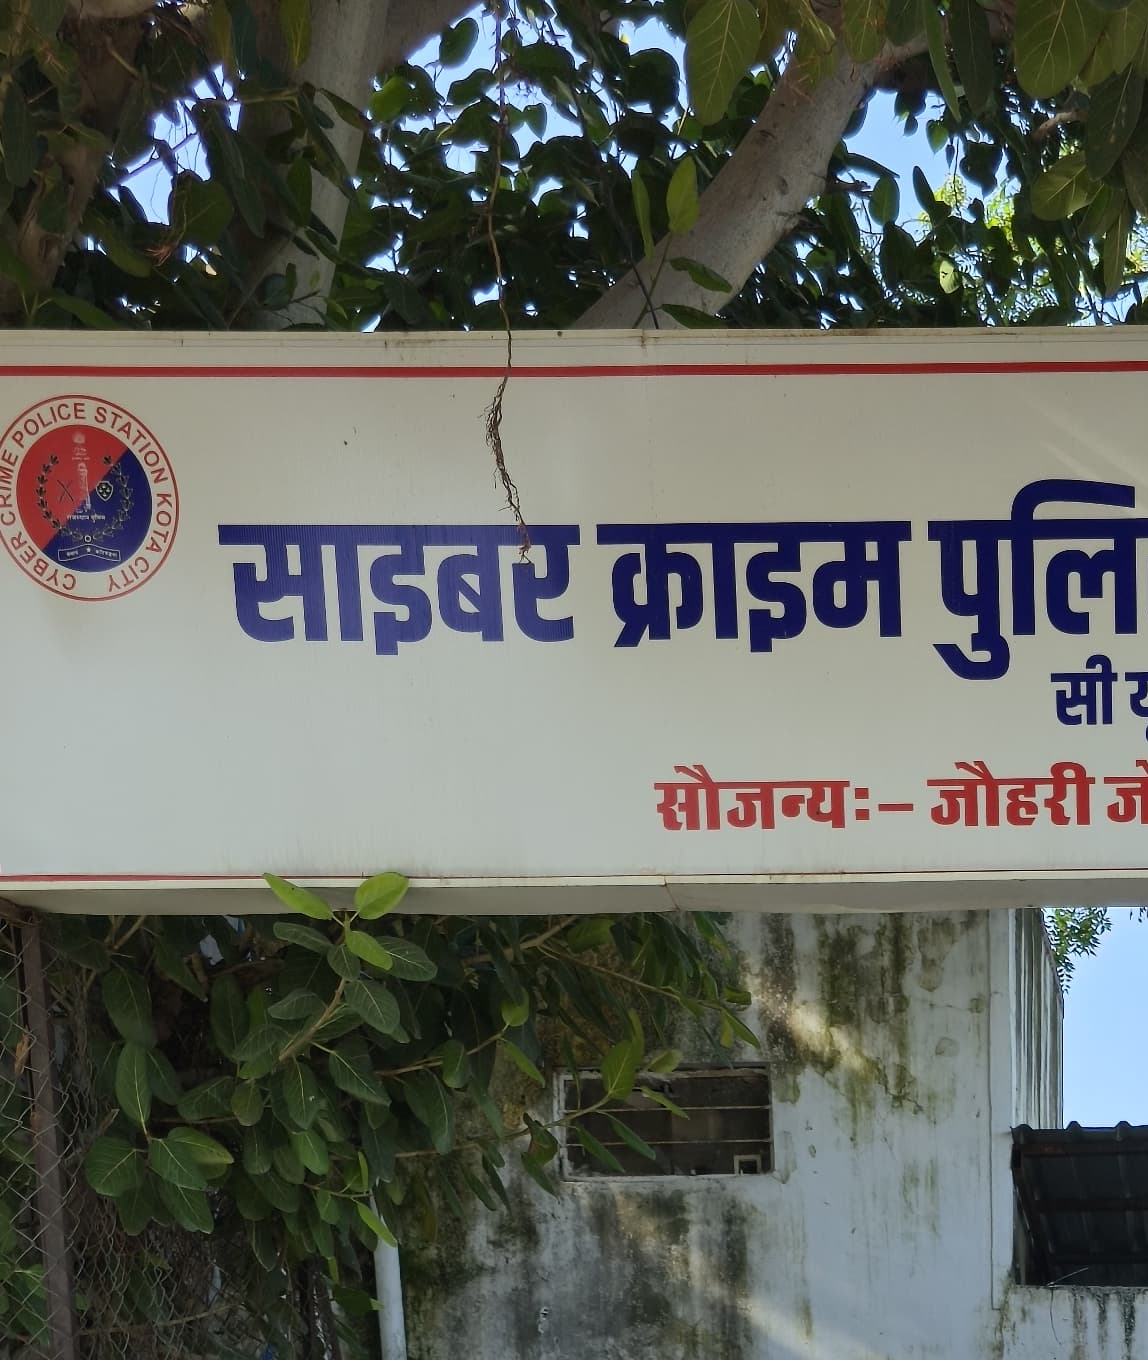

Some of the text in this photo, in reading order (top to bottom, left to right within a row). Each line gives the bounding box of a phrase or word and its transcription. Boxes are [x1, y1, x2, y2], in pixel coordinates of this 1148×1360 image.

[0, 403, 174, 593] CYBER CRIME POLICE STATION KOTA CITY
[218, 524, 581, 656] साइबर
[597, 520, 912, 653] क्राइम
[1050, 654, 1118, 727] सी
[926, 760, 1096, 828] जौहरी
